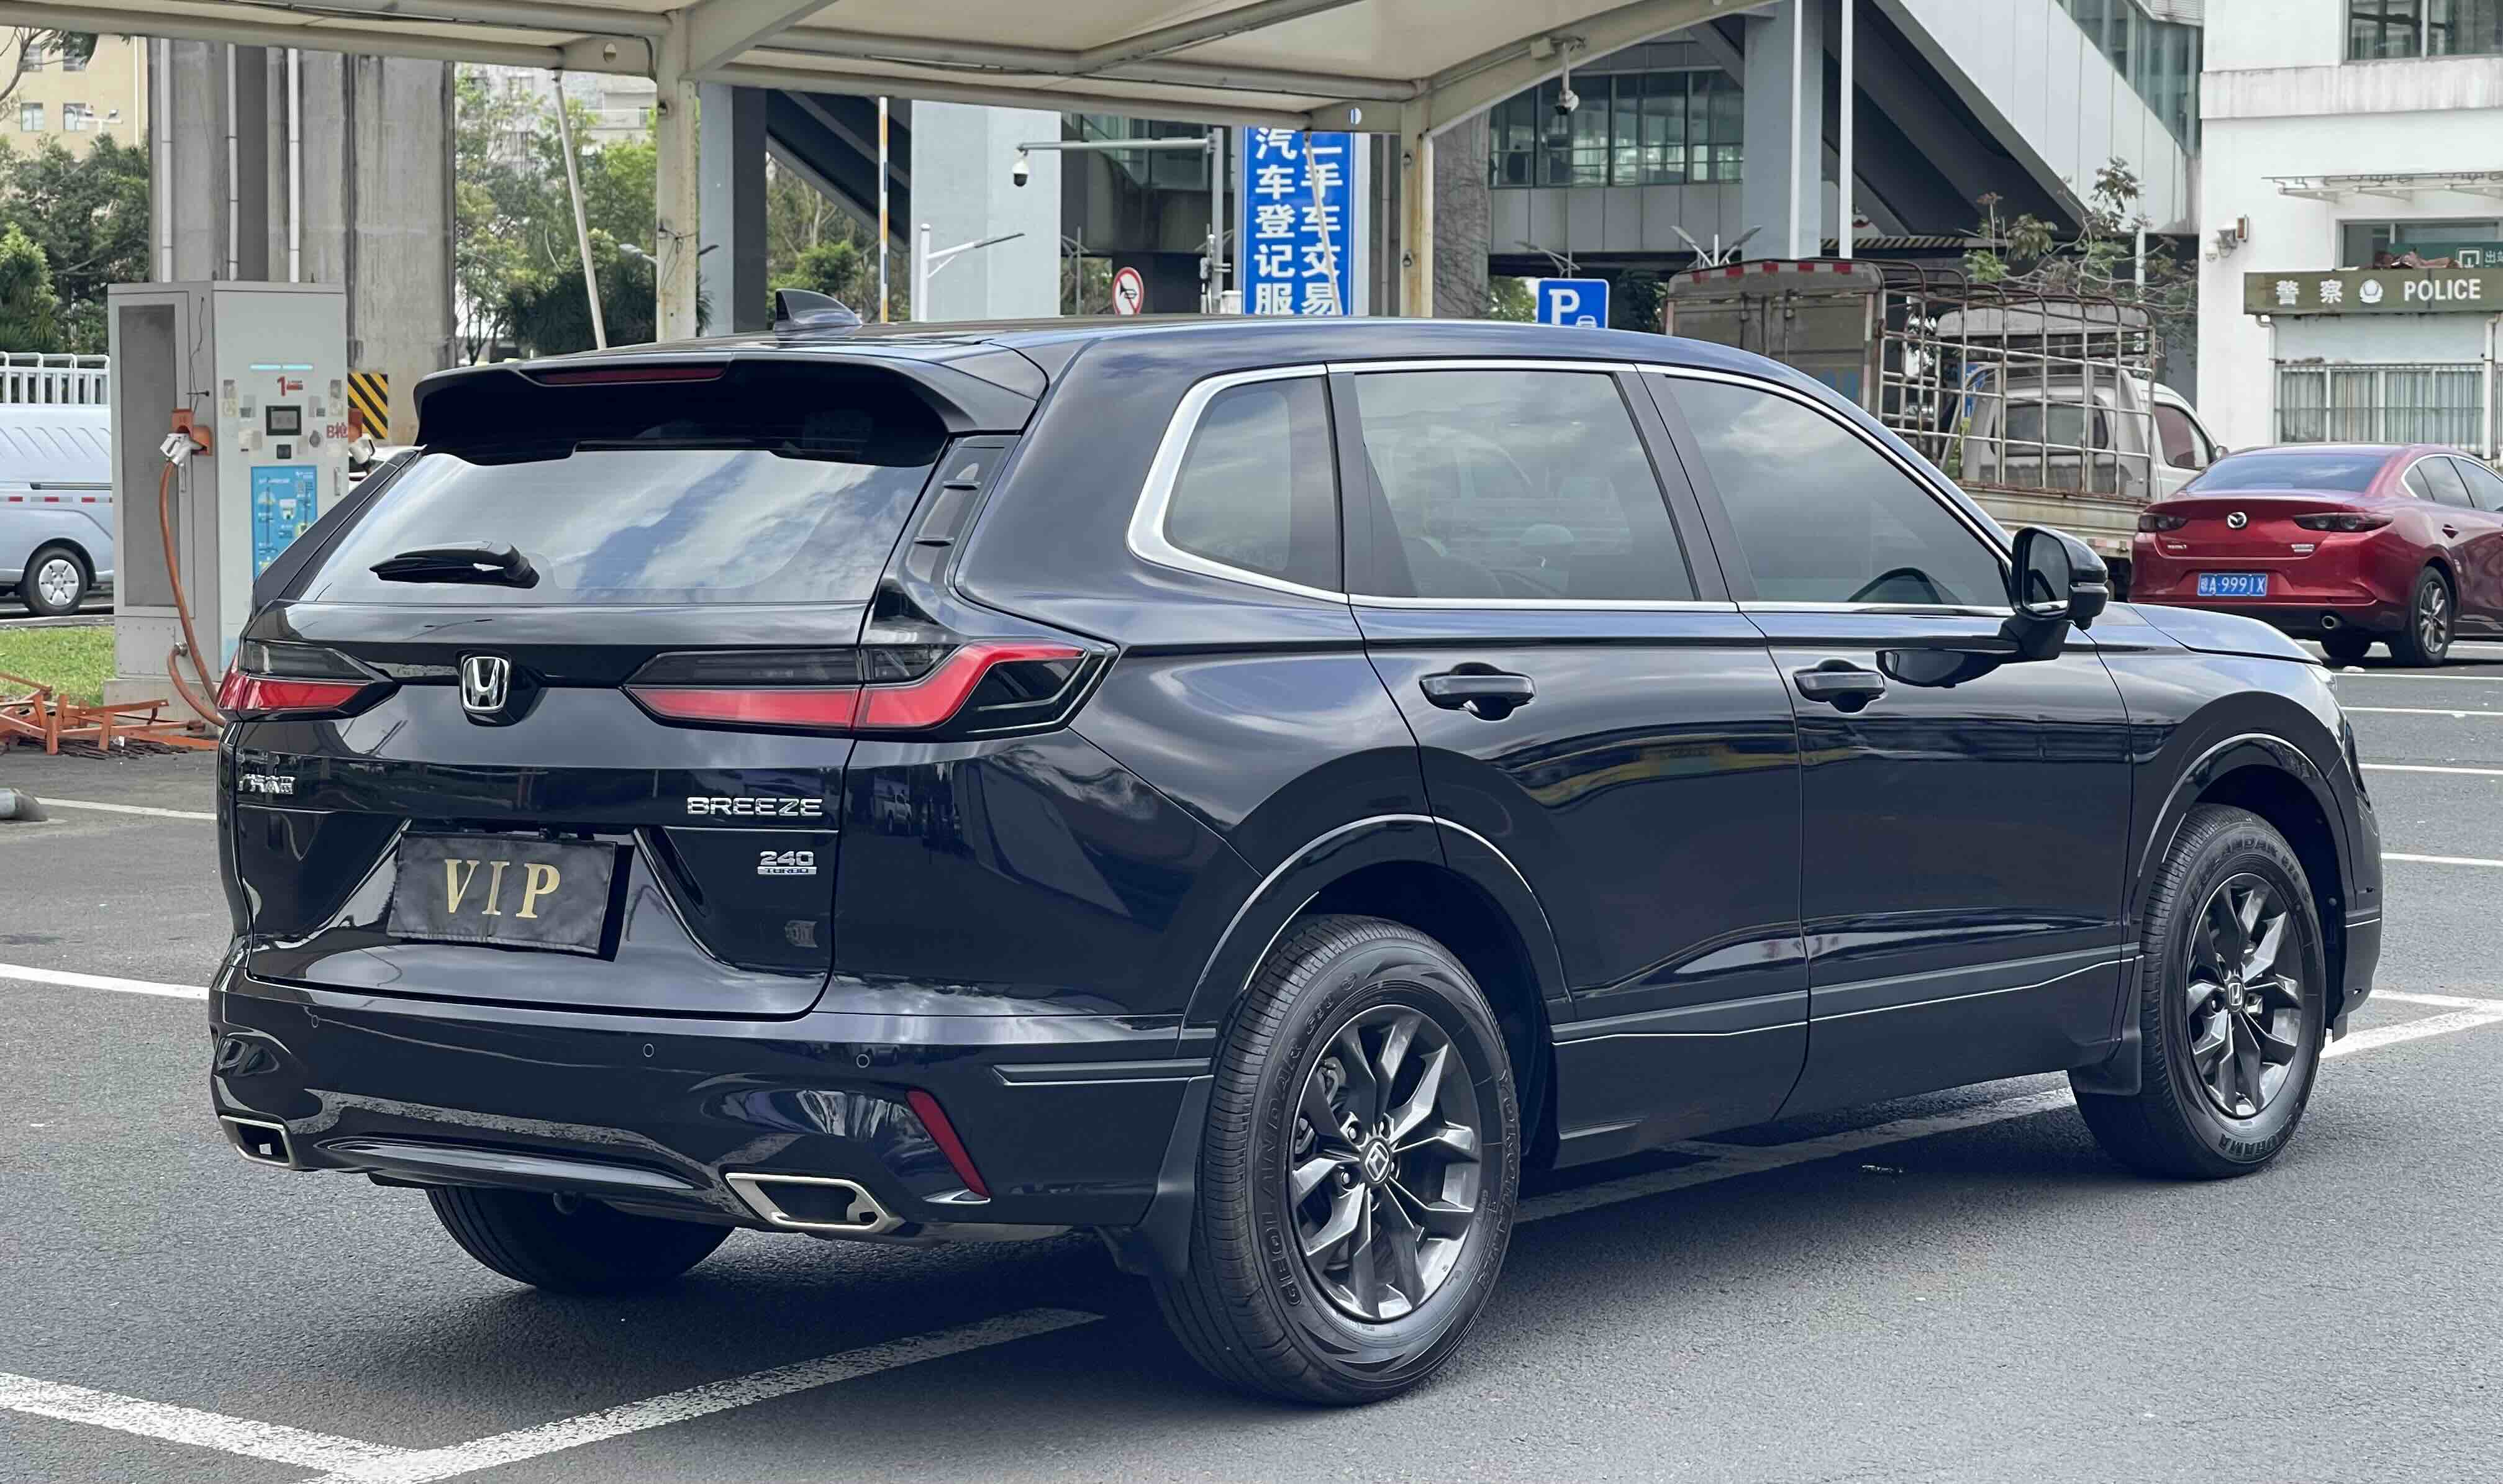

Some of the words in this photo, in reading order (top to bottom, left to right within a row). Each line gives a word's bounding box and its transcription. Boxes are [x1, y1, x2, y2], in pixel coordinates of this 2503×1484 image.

[1254, 128, 1297, 315] 汽车登记服
[1548, 289, 1580, 325] P
[2276, 279, 2343, 305] 警察
[2404, 279, 2481, 301] POLICE
[687, 797, 823, 816] BREEZE
[760, 851, 814, 866] 240
[445, 859, 560, 918] VIP
